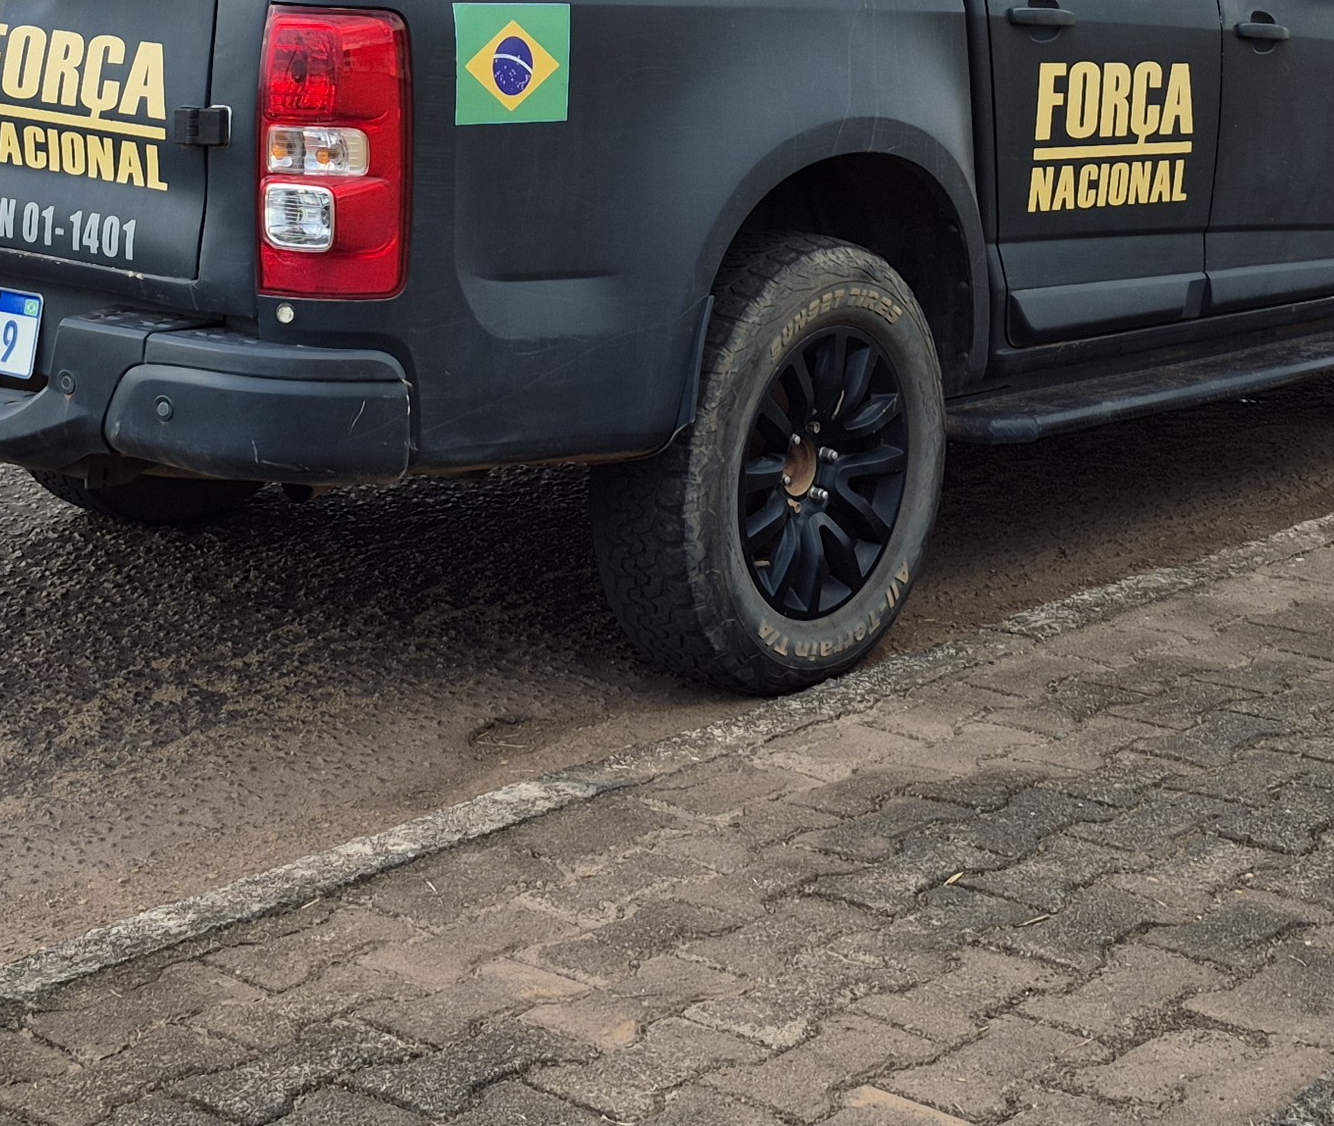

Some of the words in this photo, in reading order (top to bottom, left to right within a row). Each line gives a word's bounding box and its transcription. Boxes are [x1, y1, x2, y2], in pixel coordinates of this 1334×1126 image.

[1035, 61, 1194, 143] FORÇA
[1027, 159, 1187, 213] NACIONAL
[22, 201, 137, 261] 01-1401
[847, 287, 903, 325] TIRES
[758, 618, 790, 657] T/A
[796, 559, 909, 662] All-Terrain
